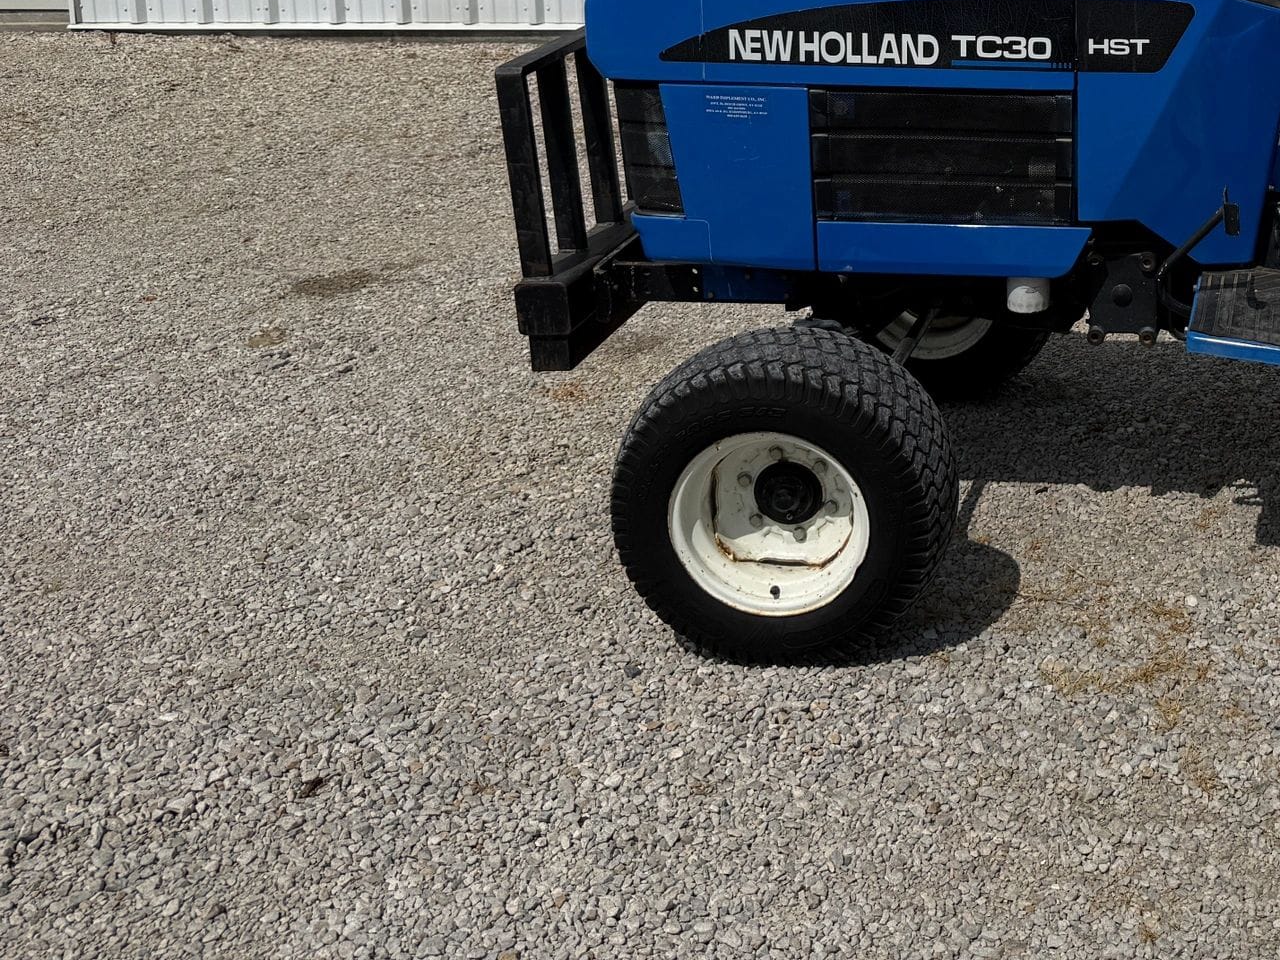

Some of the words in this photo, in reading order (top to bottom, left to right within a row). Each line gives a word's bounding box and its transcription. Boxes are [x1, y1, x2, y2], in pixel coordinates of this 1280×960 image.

[728, 29, 793, 61] NEW
[799, 31, 939, 66] HOLLAND
[951, 34, 1052, 59] TC30
[1088, 38, 1150, 56] HST
